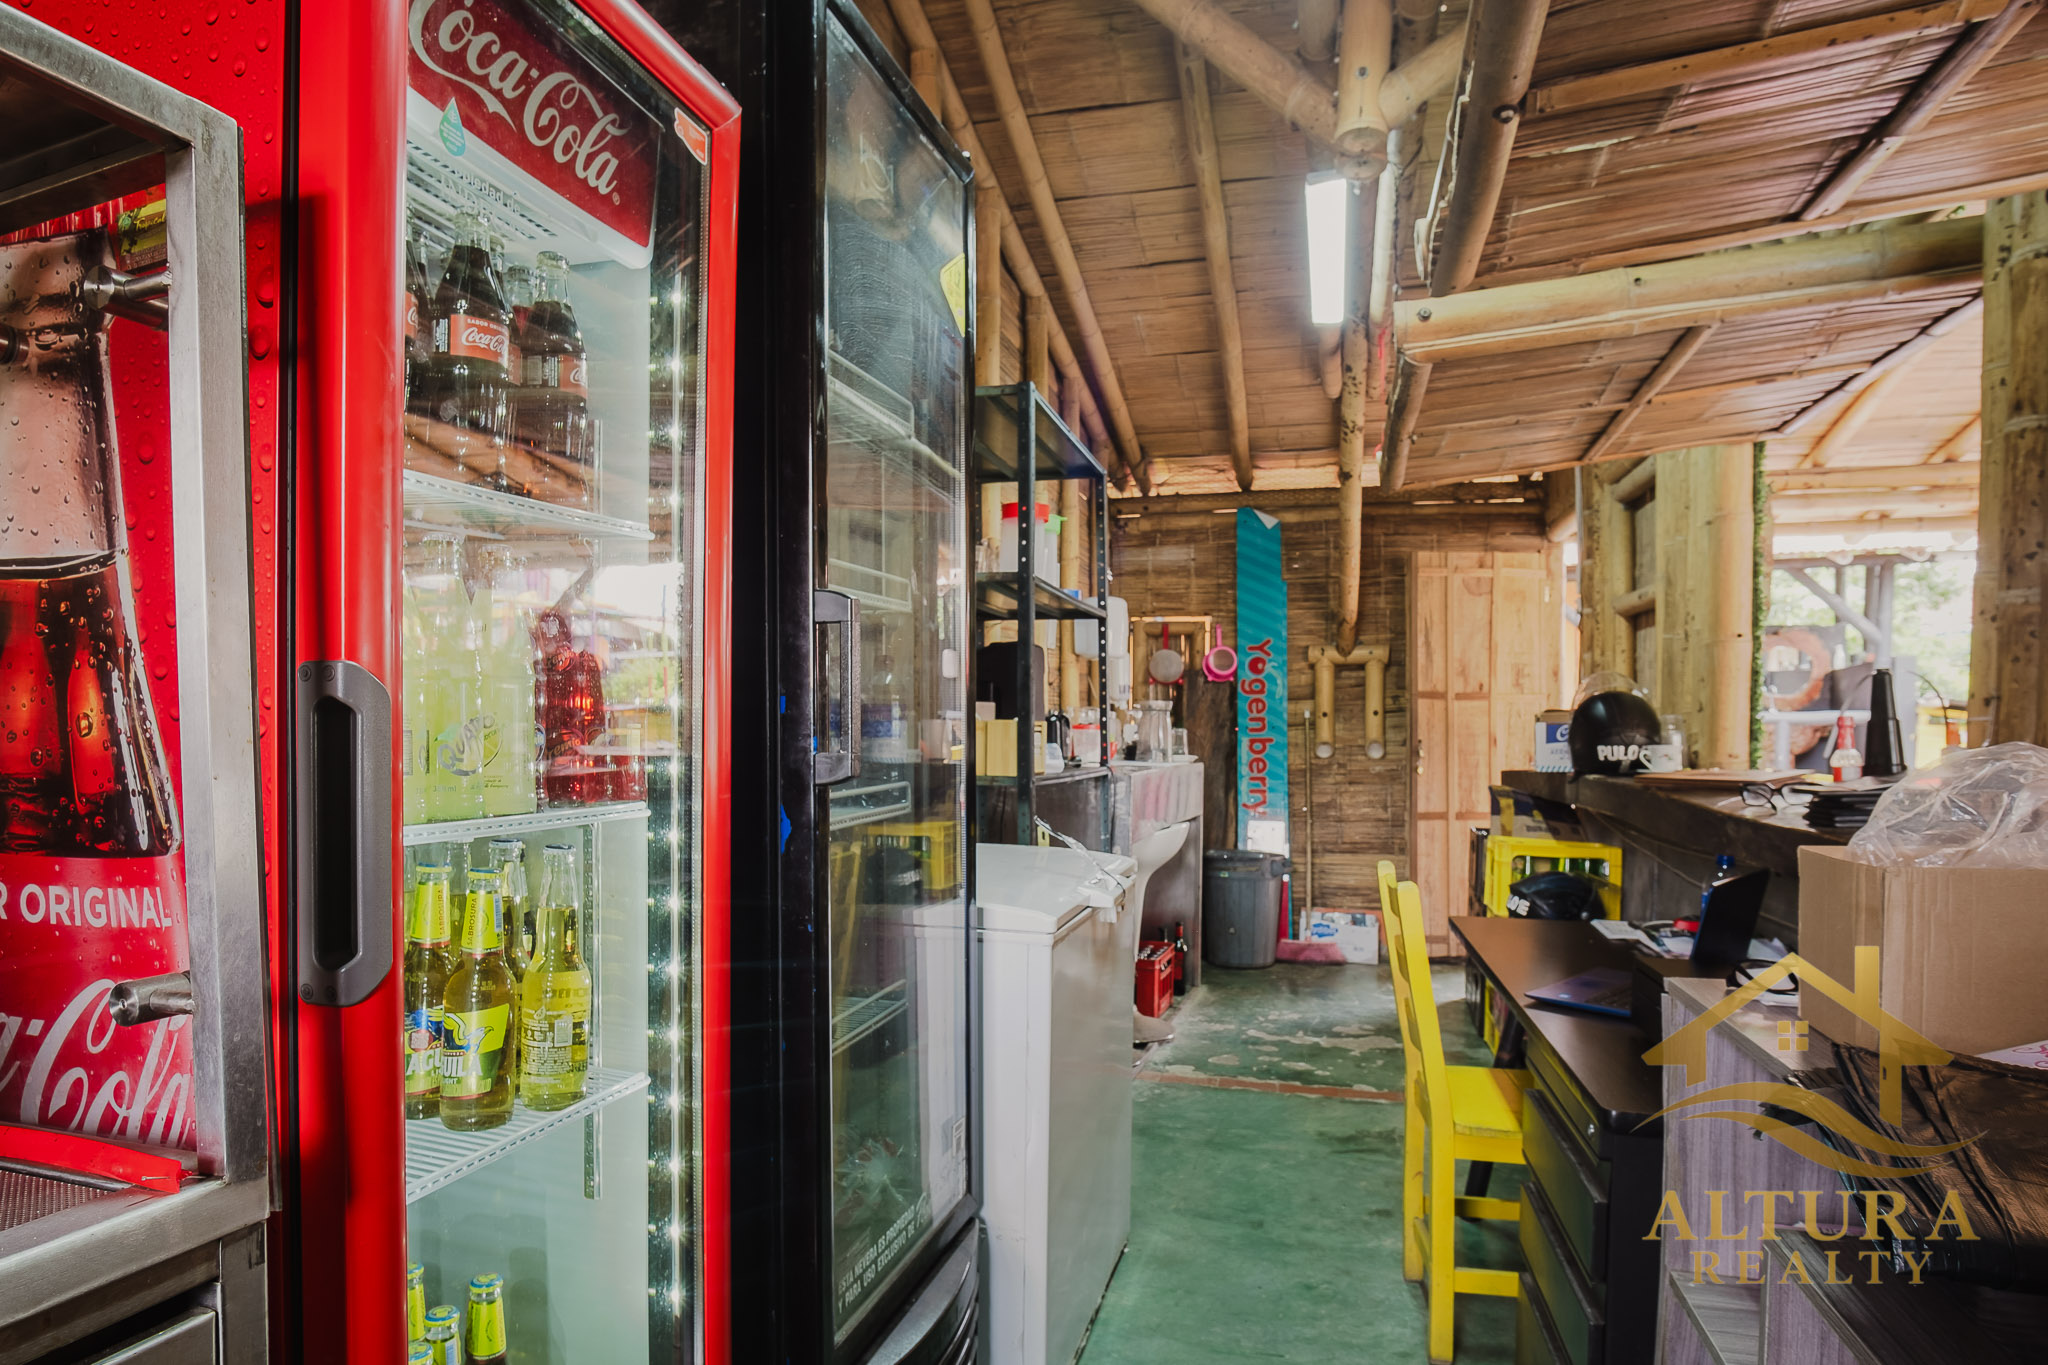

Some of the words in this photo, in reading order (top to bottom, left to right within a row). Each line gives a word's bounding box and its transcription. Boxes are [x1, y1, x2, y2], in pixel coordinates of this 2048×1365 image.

[461, 327, 507, 352] Coca-Co
[467, 318, 489, 327] SABOR
[1240, 638, 1276, 817] Yogenberry
[1597, 744, 1640, 762] PULO
[20, 883, 173, 928] ORIGINAL
[466, 897, 478, 946] SABROSURA
[406, 1048, 444, 1076] AGU
[442, 1055, 483, 1078] UILA
[838, 1270, 854, 1295] ESTA
[854, 1243, 878, 1279] NEVERA
[878, 1235, 886, 1253] ES
[885, 1204, 915, 1245] PROPIEDAD
[838, 1297, 843, 1314] Y
[845, 1280, 861, 1307] PARA
[863, 1263, 876, 1287] USO
[877, 1230, 907, 1272] EXCLUSIVO
[907, 1220, 915, 1238] DE
